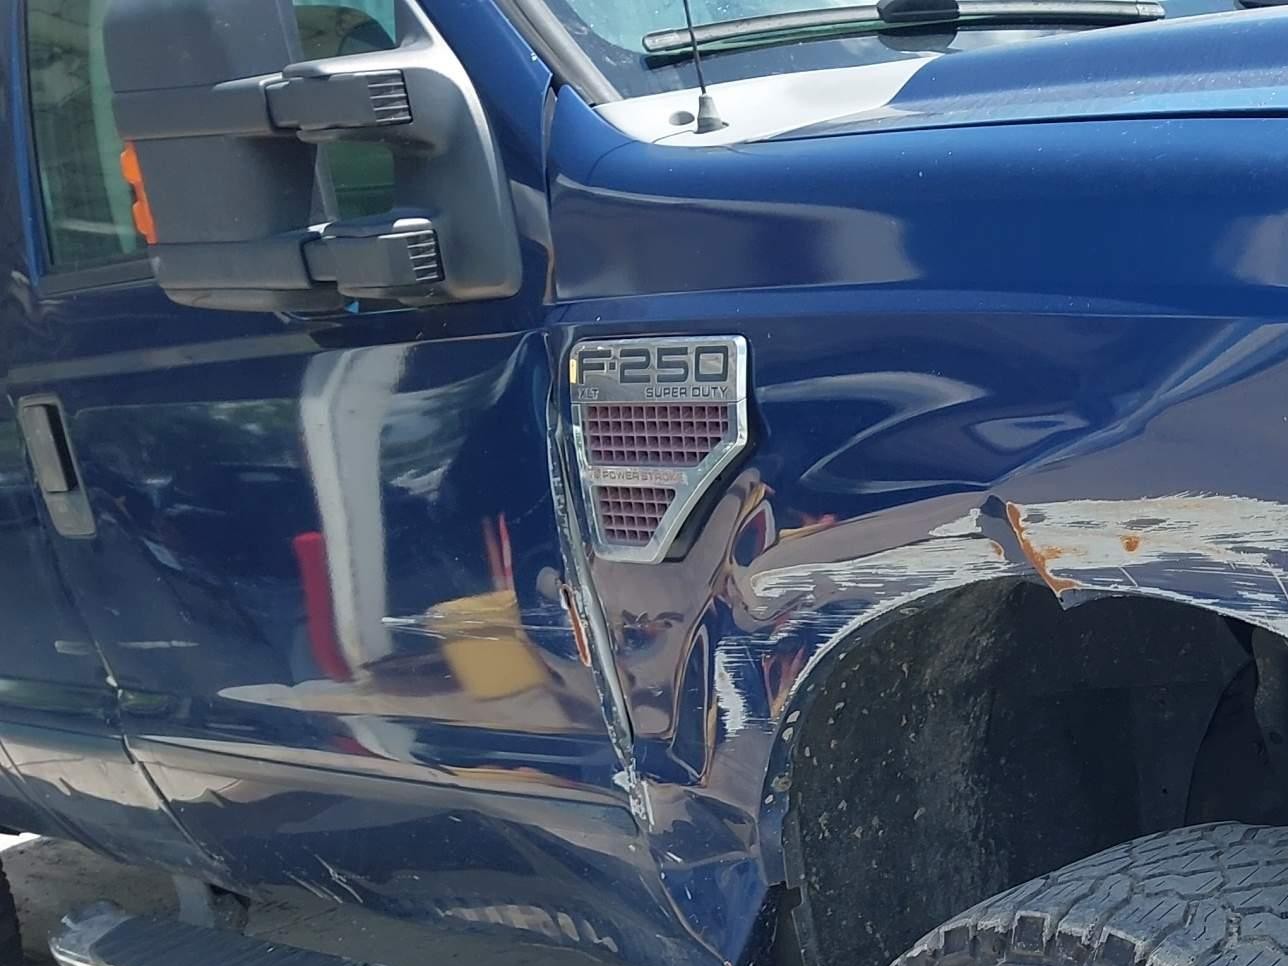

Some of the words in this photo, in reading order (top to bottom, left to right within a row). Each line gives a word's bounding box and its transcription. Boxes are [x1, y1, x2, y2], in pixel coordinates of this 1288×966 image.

[646, 387, 687, 398] SUPER
[691, 386, 729, 398] DUTY
[602, 470, 639, 481] POWER
